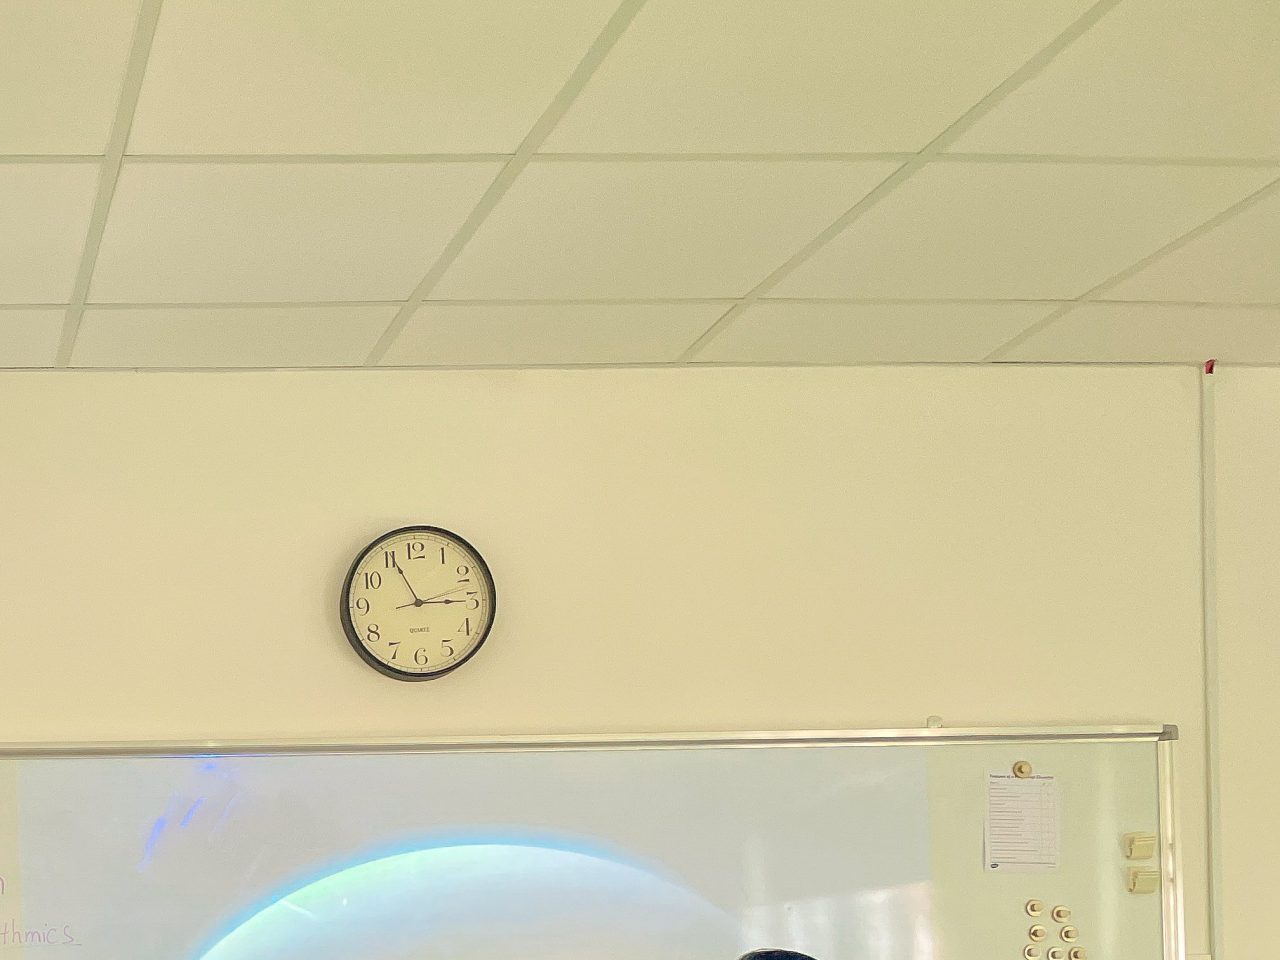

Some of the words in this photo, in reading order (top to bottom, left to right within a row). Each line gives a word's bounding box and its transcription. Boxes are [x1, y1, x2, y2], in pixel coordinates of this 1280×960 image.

[407, 542, 426, 560] 12
[439, 547, 445, 565] 1
[364, 571, 382, 590] 10
[456, 565, 470, 583] 2
[356, 597, 370, 616] 9
[465, 591, 480, 610] 3
[367, 623, 380, 642] 8
[457, 617, 472, 636] 4
[388, 641, 401, 660] 7
[414, 647, 429, 666] 6
[441, 639, 455, 657] 5
